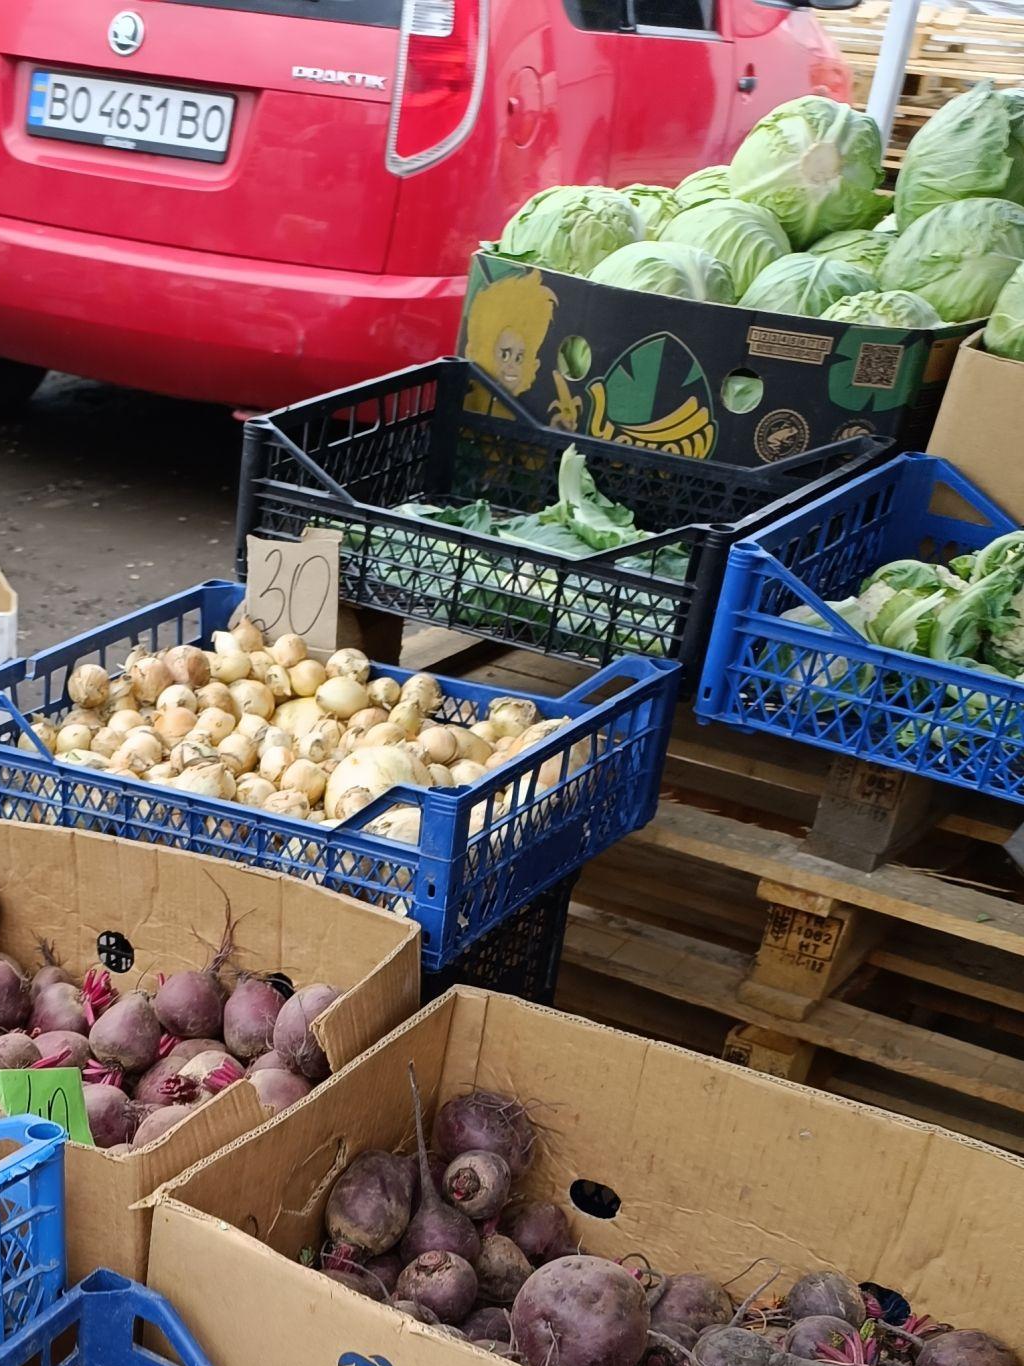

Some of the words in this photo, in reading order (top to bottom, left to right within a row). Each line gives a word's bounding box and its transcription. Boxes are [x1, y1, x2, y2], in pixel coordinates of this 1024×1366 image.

[291, 65, 389, 90] PRAKTIK
[48, 82, 91, 124] BO
[98, 90, 170, 136] 4651
[176, 100, 226, 143] BO
[251, 548, 331, 636] 30
[798, 941, 820, 955] HT
